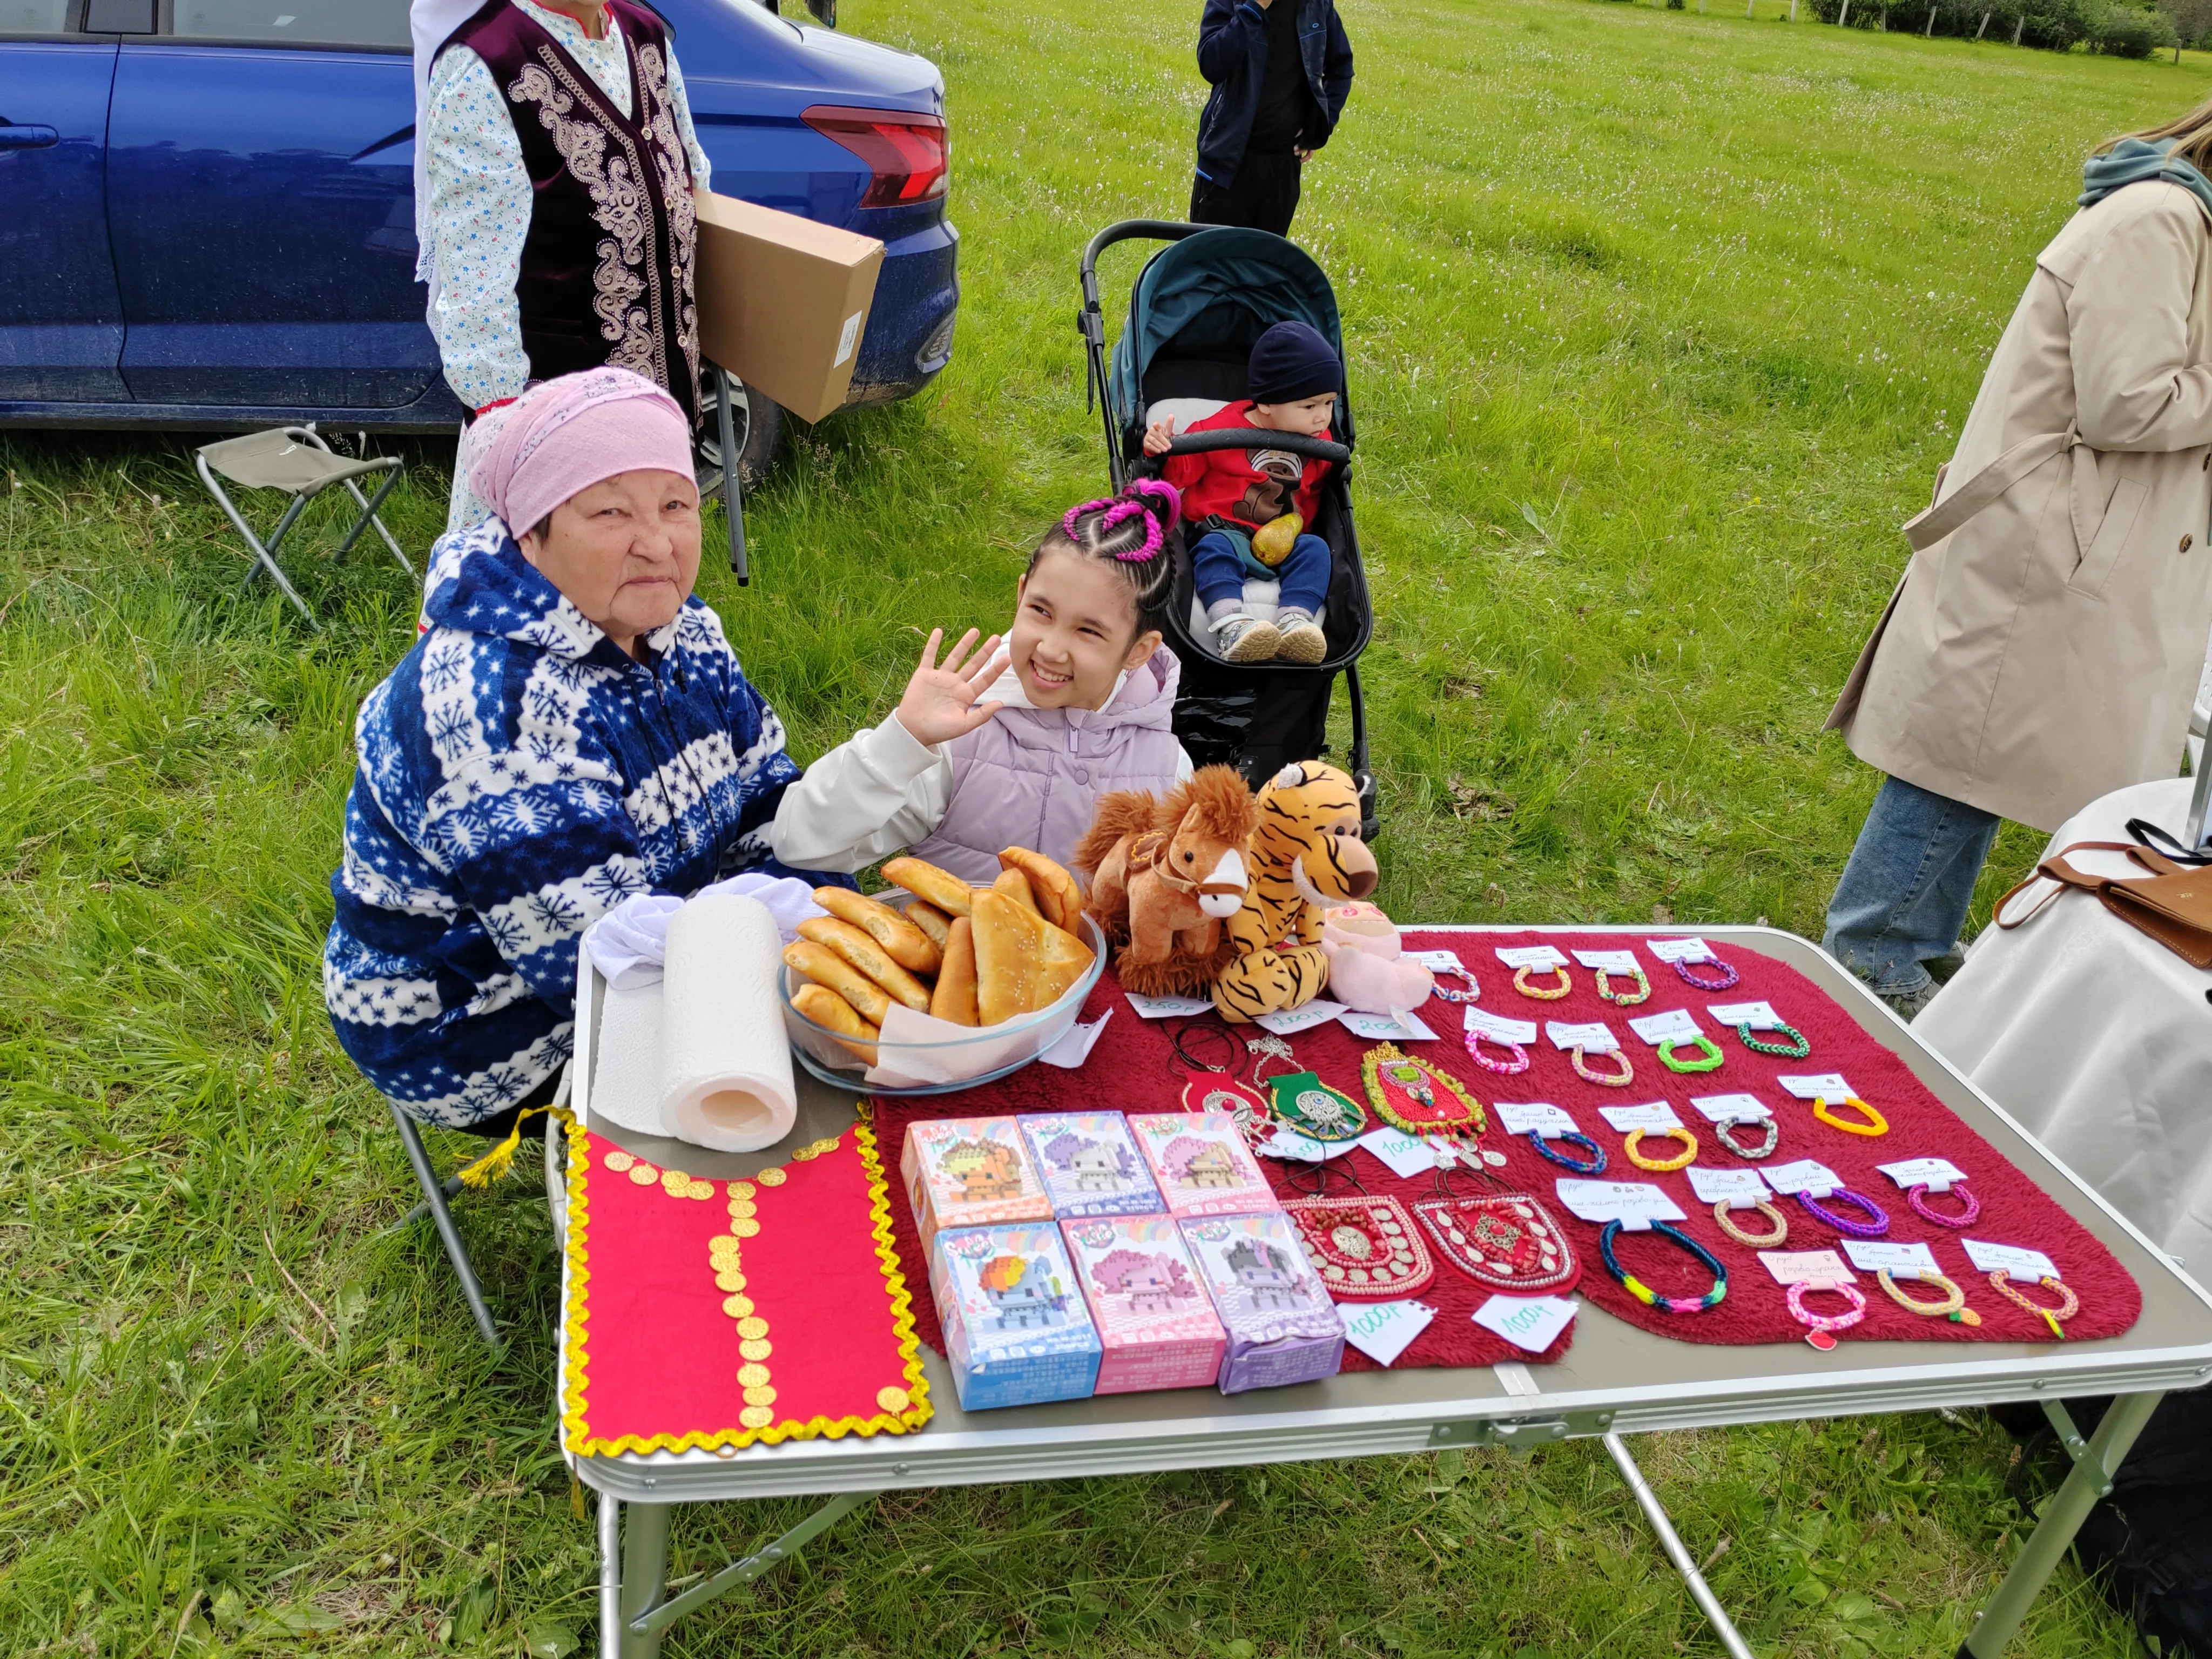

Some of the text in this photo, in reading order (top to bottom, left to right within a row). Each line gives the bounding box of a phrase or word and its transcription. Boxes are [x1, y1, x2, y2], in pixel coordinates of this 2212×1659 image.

[1359, 1019, 1402, 1031] 200
[1382, 1136, 1427, 1157] 1000
[1700, 1171, 1714, 1181] руб
[1568, 1183, 1583, 1193] руб
[1856, 1243, 1873, 1251] руб
[1776, 1254, 1794, 1264] руб
